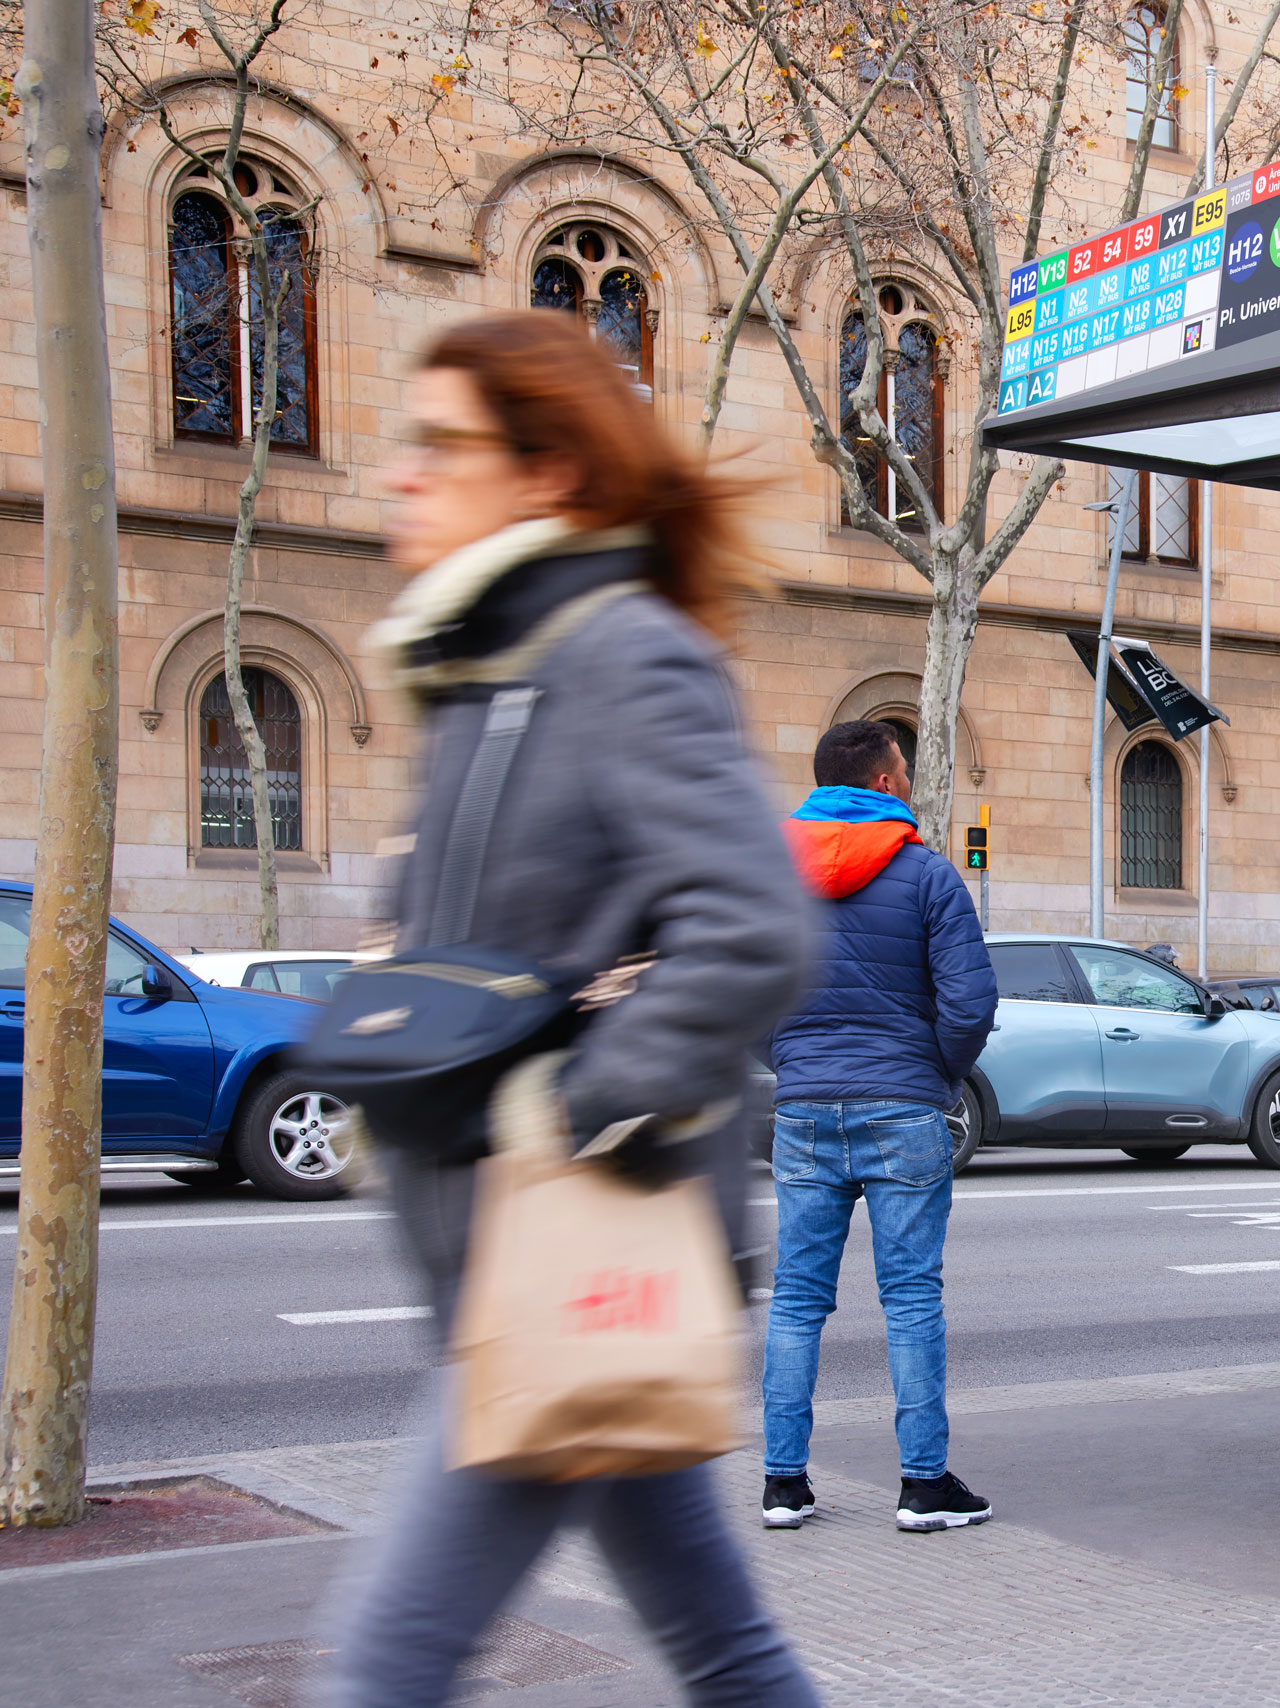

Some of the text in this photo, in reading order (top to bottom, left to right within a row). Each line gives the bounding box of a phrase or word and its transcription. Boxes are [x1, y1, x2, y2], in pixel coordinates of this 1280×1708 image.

[1230, 189, 1251, 207] 1075
[1164, 211, 1187, 241] X1
[1195, 198, 1223, 227] E95
[1103, 237, 1122, 262] 54
[1134, 225, 1153, 250] 59
[1191, 235, 1220, 263] N13
[1228, 233, 1263, 266] H12
[1040, 259, 1066, 286] V13
[1073, 249, 1092, 274] 52
[1131, 263, 1149, 287] N8
[1159, 248, 1187, 276] N12
[1011, 270, 1037, 298] H12
[1100, 275, 1118, 297] N3
[1040, 298, 1056, 321] N1
[1069, 288, 1087, 309] N2
[1155, 289, 1183, 317] N28
[1009, 309, 1032, 334] L95
[1092, 311, 1119, 338] N17
[1123, 300, 1150, 327] N18
[1220, 307, 1236, 328] Pl.
[1033, 333, 1058, 359] N15
[1062, 323, 1088, 348] N16
[1005, 338, 1029, 367] N14
[1002, 382, 1023, 410] A1
[1028, 372, 1054, 401] A2
